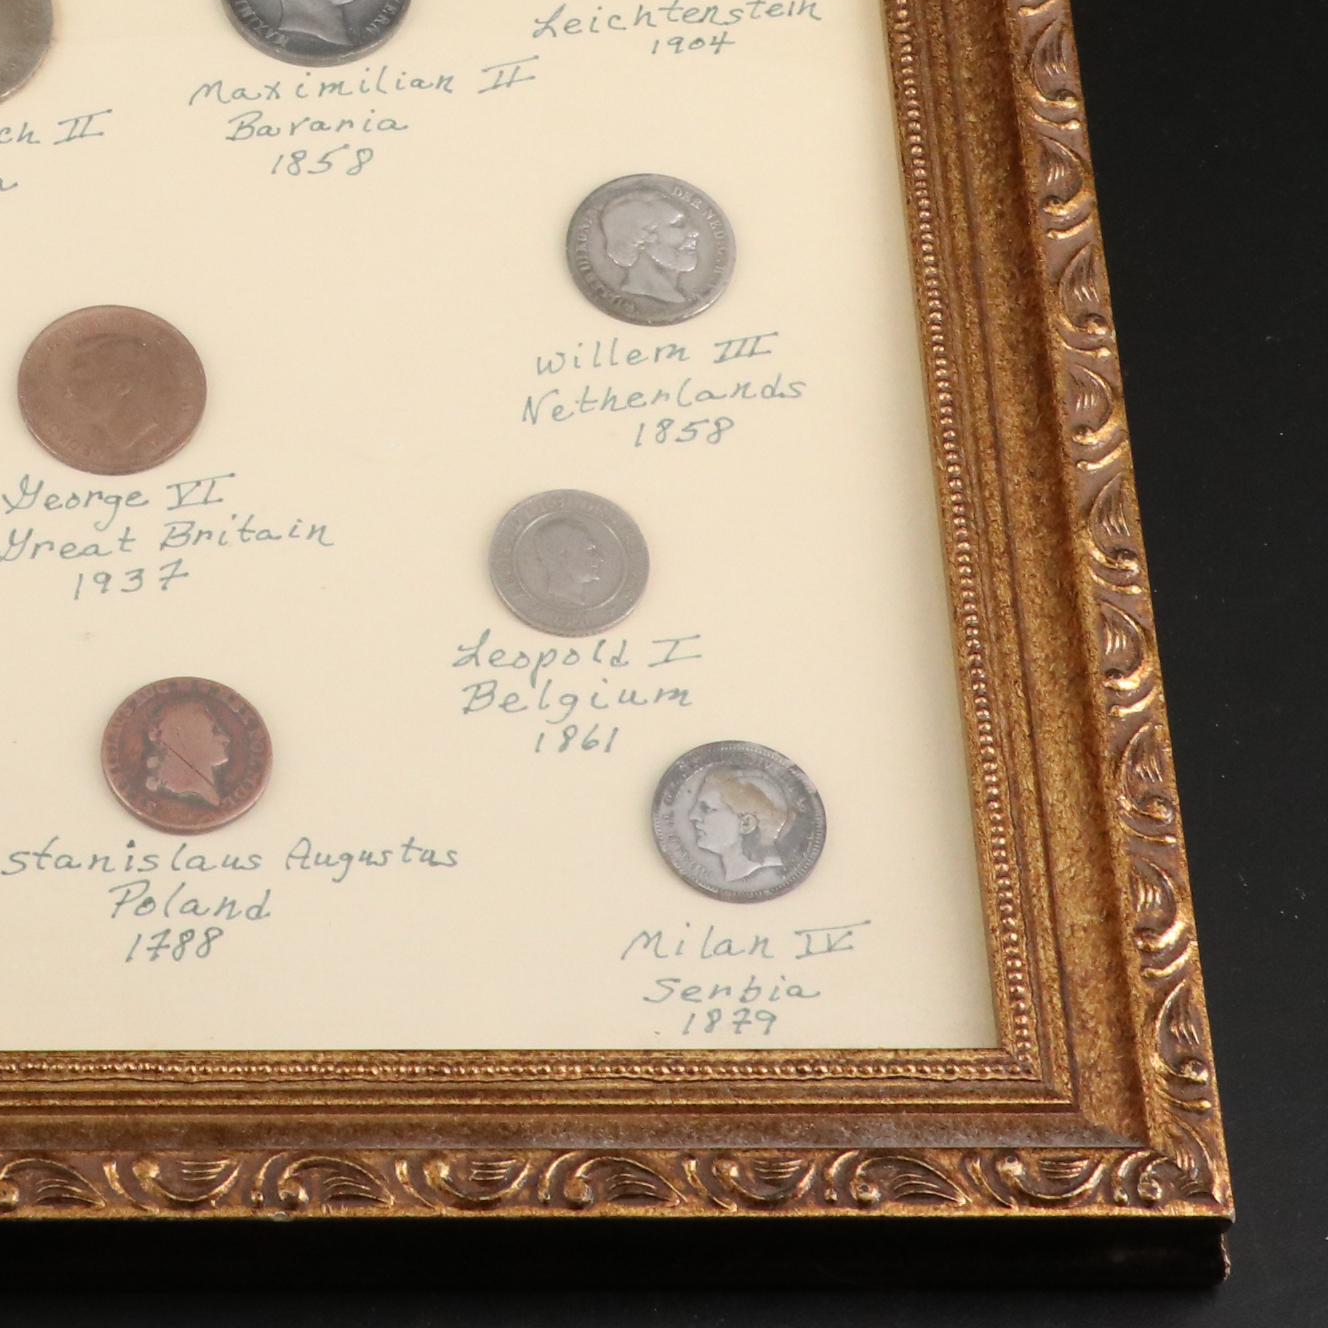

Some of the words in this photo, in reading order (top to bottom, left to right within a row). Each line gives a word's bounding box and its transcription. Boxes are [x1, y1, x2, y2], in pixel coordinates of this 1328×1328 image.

[651, 31, 735, 55] 1904
[188, 65, 454, 106] Maximilian
[478, 55, 539, 94] II
[53, 109, 112, 145] II
[225, 109, 409, 141] Bavaria
[271, 144, 374, 176] 1858
[713, 331, 779, 364] III
[522, 373, 806, 425] Netherlands
[634, 416, 735, 448] 1858
[0, 473, 150, 530] George
[163, 473, 235, 510] VI
[160, 513, 334, 551] Britain
[74, 558, 189, 600] 1937
[452, 628, 629, 688] Leopold
[648, 634, 702, 668] I
[462, 679, 692, 724] Belgium
[534, 723, 619, 753] 1861
[285, 836, 458, 883] Augustus
[108, 879, 271, 921] Poland
[125, 926, 224, 963] 1788
[621, 922, 774, 960] Milan
[794, 920, 871, 960] IV
[642, 975, 821, 1003] Serbia
[682, 1007, 777, 1035] 1879
